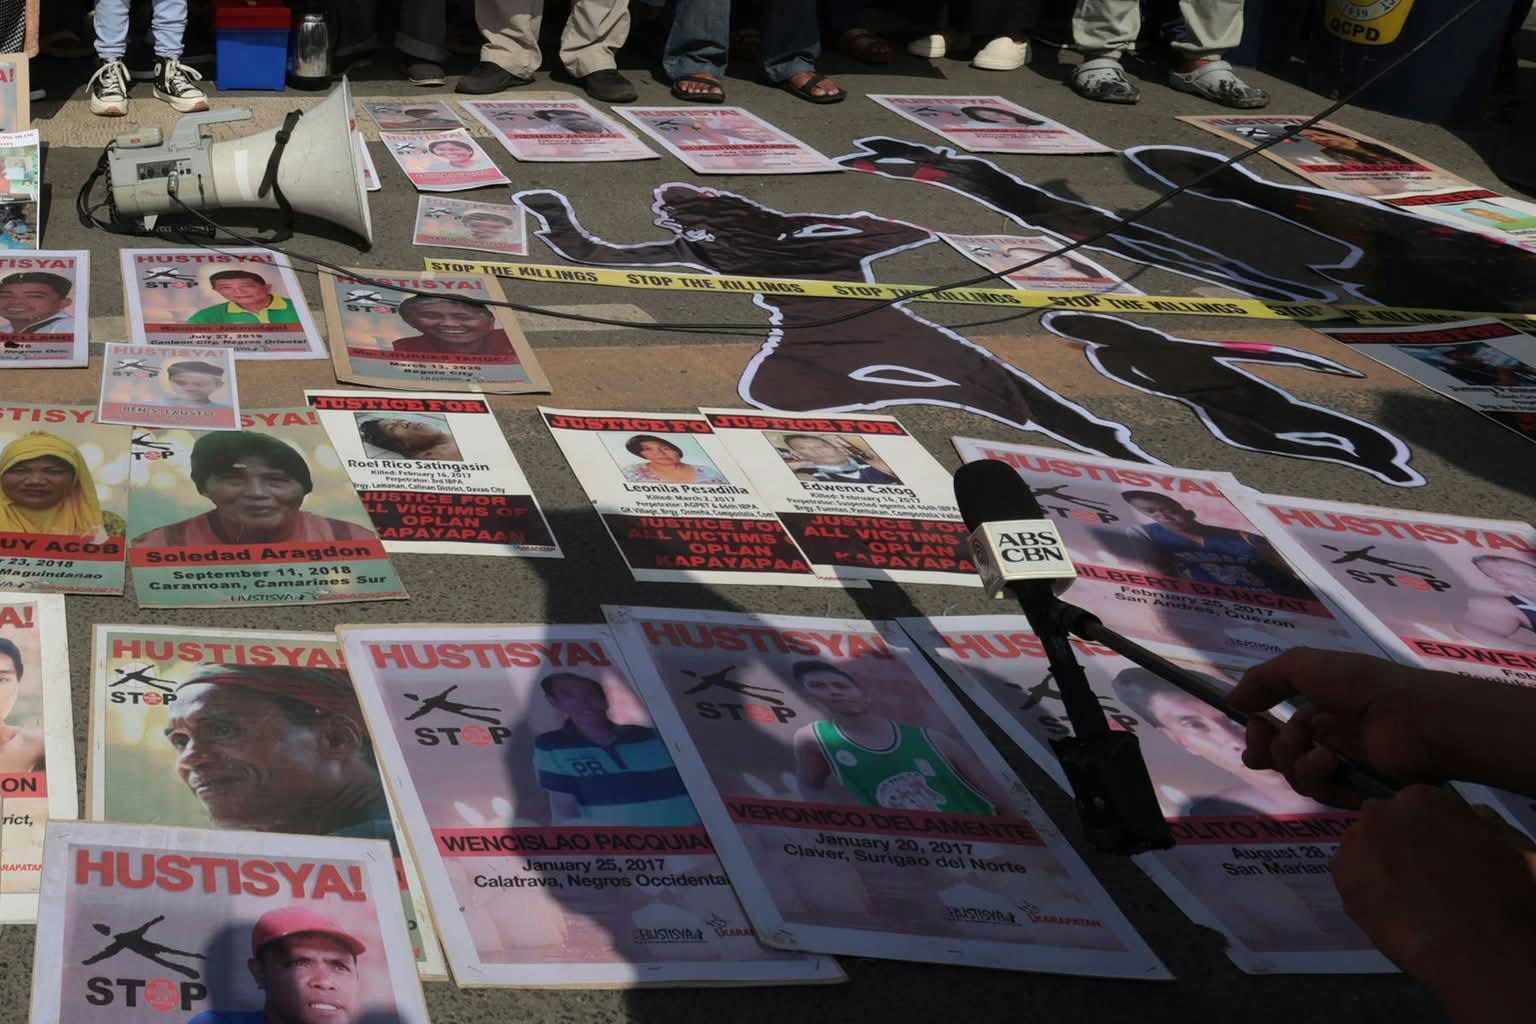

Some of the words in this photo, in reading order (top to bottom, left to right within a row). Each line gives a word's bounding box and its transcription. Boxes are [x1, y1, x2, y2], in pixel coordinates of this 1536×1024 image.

[431, 262, 476, 274] STOP
[481, 265, 514, 277] THE
[519, 267, 599, 283] KILLINGS
[348, 458, 379, 469] Roel
[382, 460, 411, 470] Rico
[415, 461, 490, 473] Satingasin
[623, 483, 680, 494] Leonila
[683, 485, 749, 496] Pesadilla
[800, 482, 862, 494] Edweno
[867, 485, 916, 498] Catog
[0, 537, 40, 550] UY
[44, 540, 120, 554] ACOB
[998, 530, 1057, 547] ABS
[146, 549, 251, 563] Soledad
[261, 545, 371, 562] Aragdon
[1000, 546, 1064, 563] CBN
[173, 568, 270, 581] September
[276, 568, 303, 579] 11,
[309, 566, 351, 576] 2018
[149, 579, 248, 592] Caramoan,
[254, 576, 351, 589] Camarines
[356, 574, 387, 585] Sur
[640, 622, 895, 660] HUSTISYA!
[370, 643, 613, 669] HUSTISYA!
[729, 802, 865, 827] VERONICO
[872, 812, 1038, 842] DELAMENTE
[441, 833, 591, 852] WENCISLAO
[815, 832, 890, 852] January
[895, 837, 925, 854] 20,
[929, 840, 973, 856] 2017
[522, 858, 592, 873] January
[596, 858, 623, 873] 25,
[626, 858, 664, 871] 2017
[75, 850, 367, 900] HUSTISYA!
[86, 977, 207, 1012] STOP
